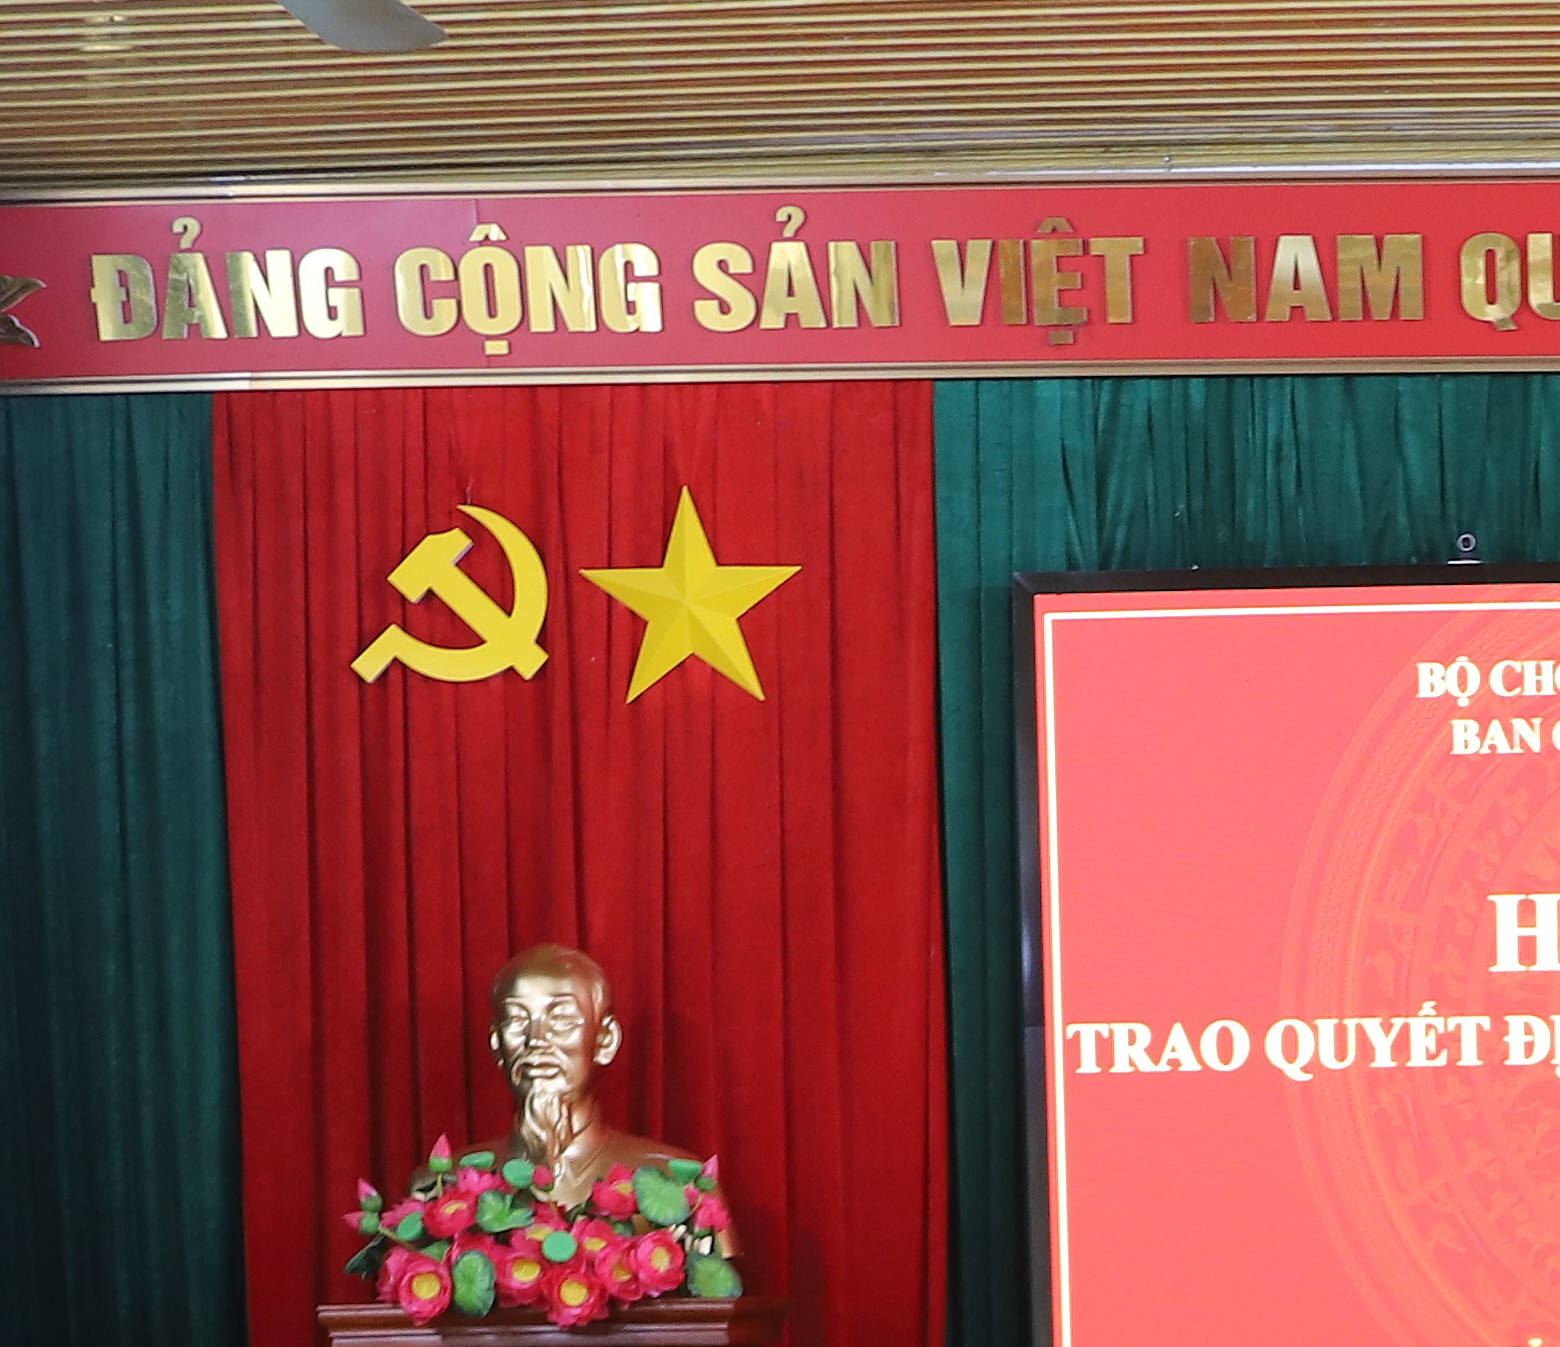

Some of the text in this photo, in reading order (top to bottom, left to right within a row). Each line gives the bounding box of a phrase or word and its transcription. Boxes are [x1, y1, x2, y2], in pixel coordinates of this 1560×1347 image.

[90, 216, 365, 342] ĐẢNG
[394, 222, 662, 356] CỘNG
[691, 205, 900, 333] SẢN
[931, 216, 1145, 346] VIỆT
[1187, 233, 1425, 324] NAM
[1416, 656, 1481, 707] BỘ
[1450, 717, 1543, 756] BAN
[1066, 1019, 1251, 1075] TRAO
[1264, 1001, 1491, 1082] QUYẾT
